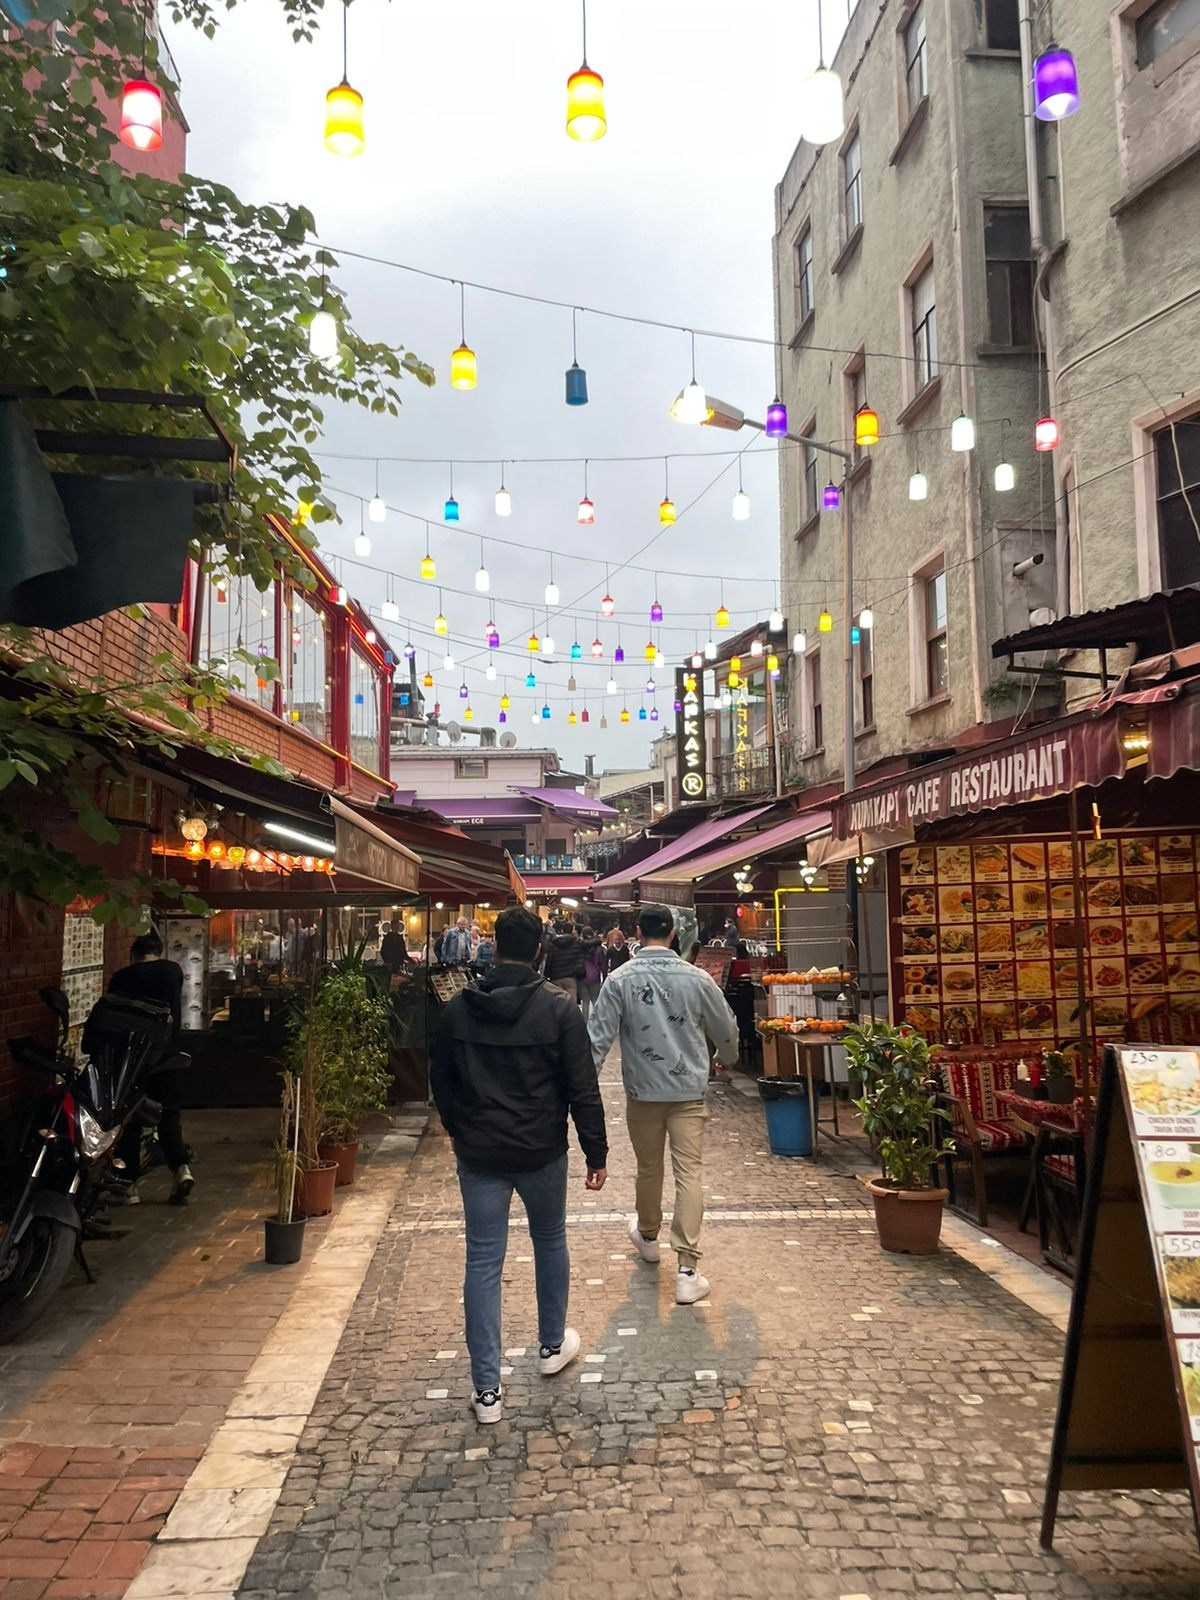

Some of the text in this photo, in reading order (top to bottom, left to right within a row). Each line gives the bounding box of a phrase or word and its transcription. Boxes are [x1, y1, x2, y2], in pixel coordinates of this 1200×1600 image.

[850, 740, 1066, 831] KUMKAPI CAFE RESTAURANT
[1130, 1052, 1158, 1065] 230
[1154, 1145, 1176, 1158] 80
